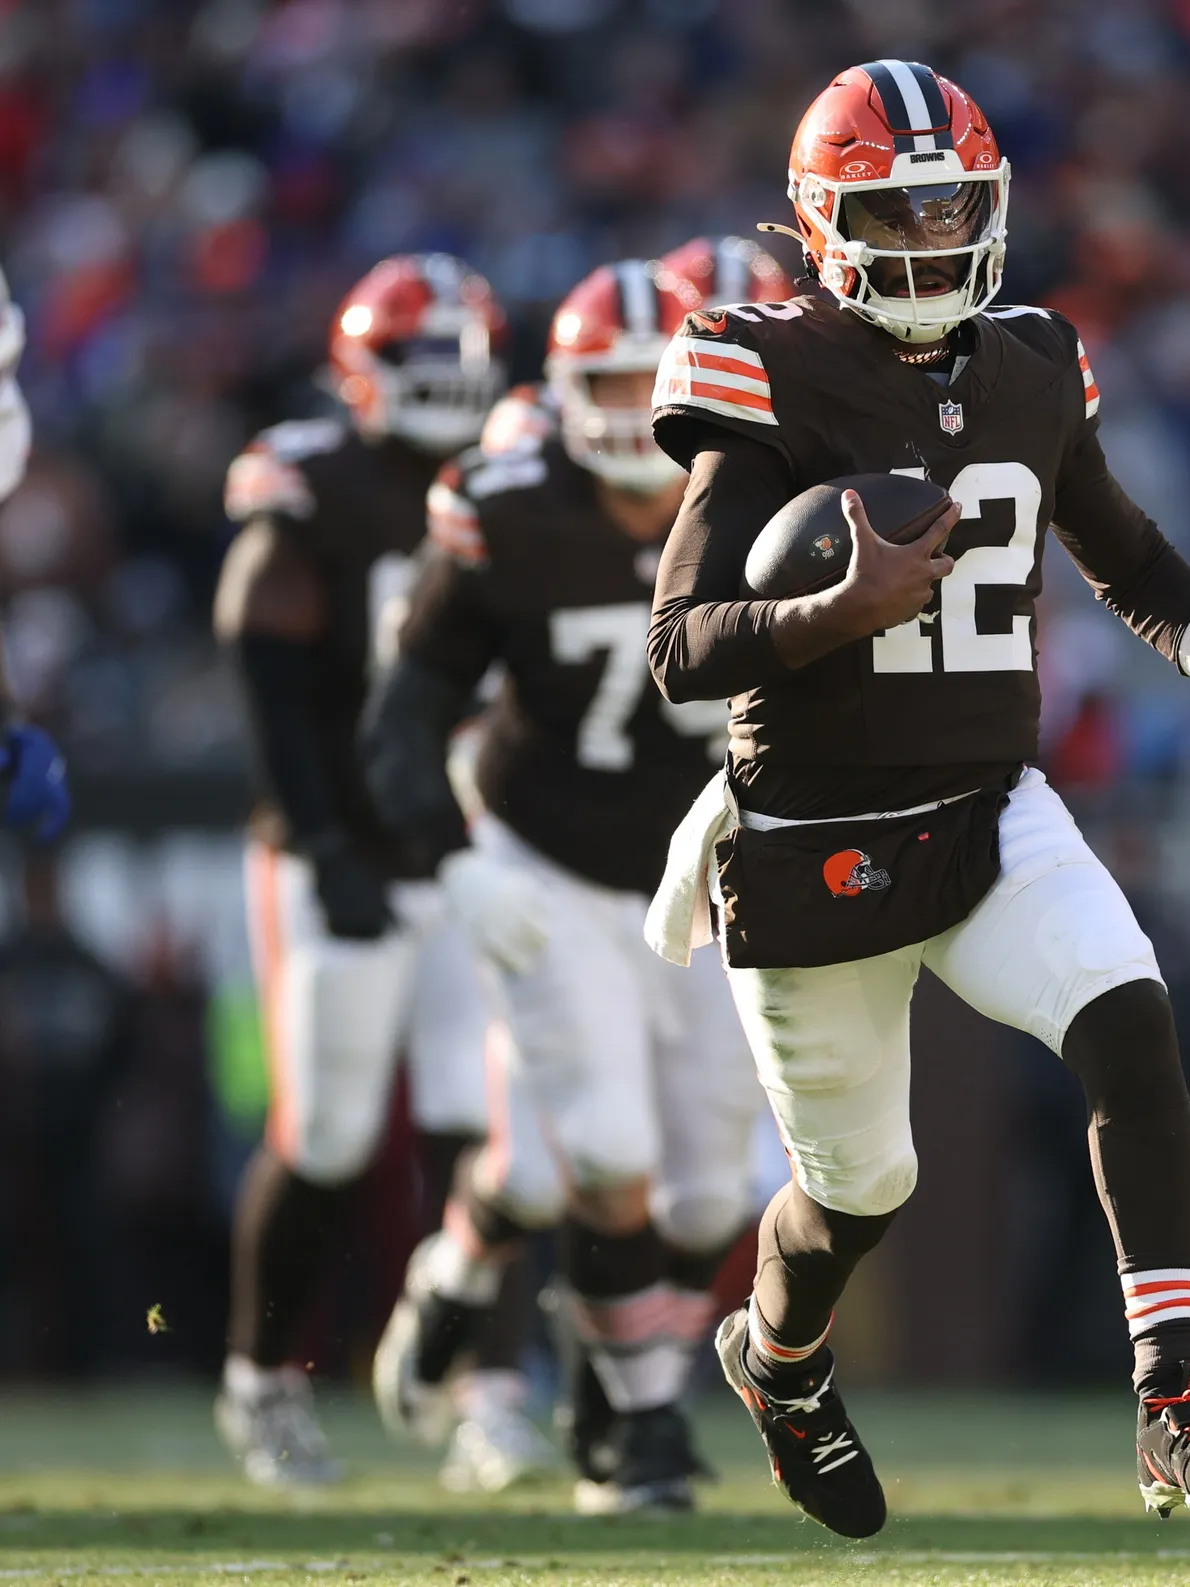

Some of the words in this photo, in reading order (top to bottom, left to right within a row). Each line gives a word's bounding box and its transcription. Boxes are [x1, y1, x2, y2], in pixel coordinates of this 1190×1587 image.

[910, 152, 946, 164] BROWNS
[840, 171, 873, 180] OAKLEY
[944, 415, 961, 429] NFL
